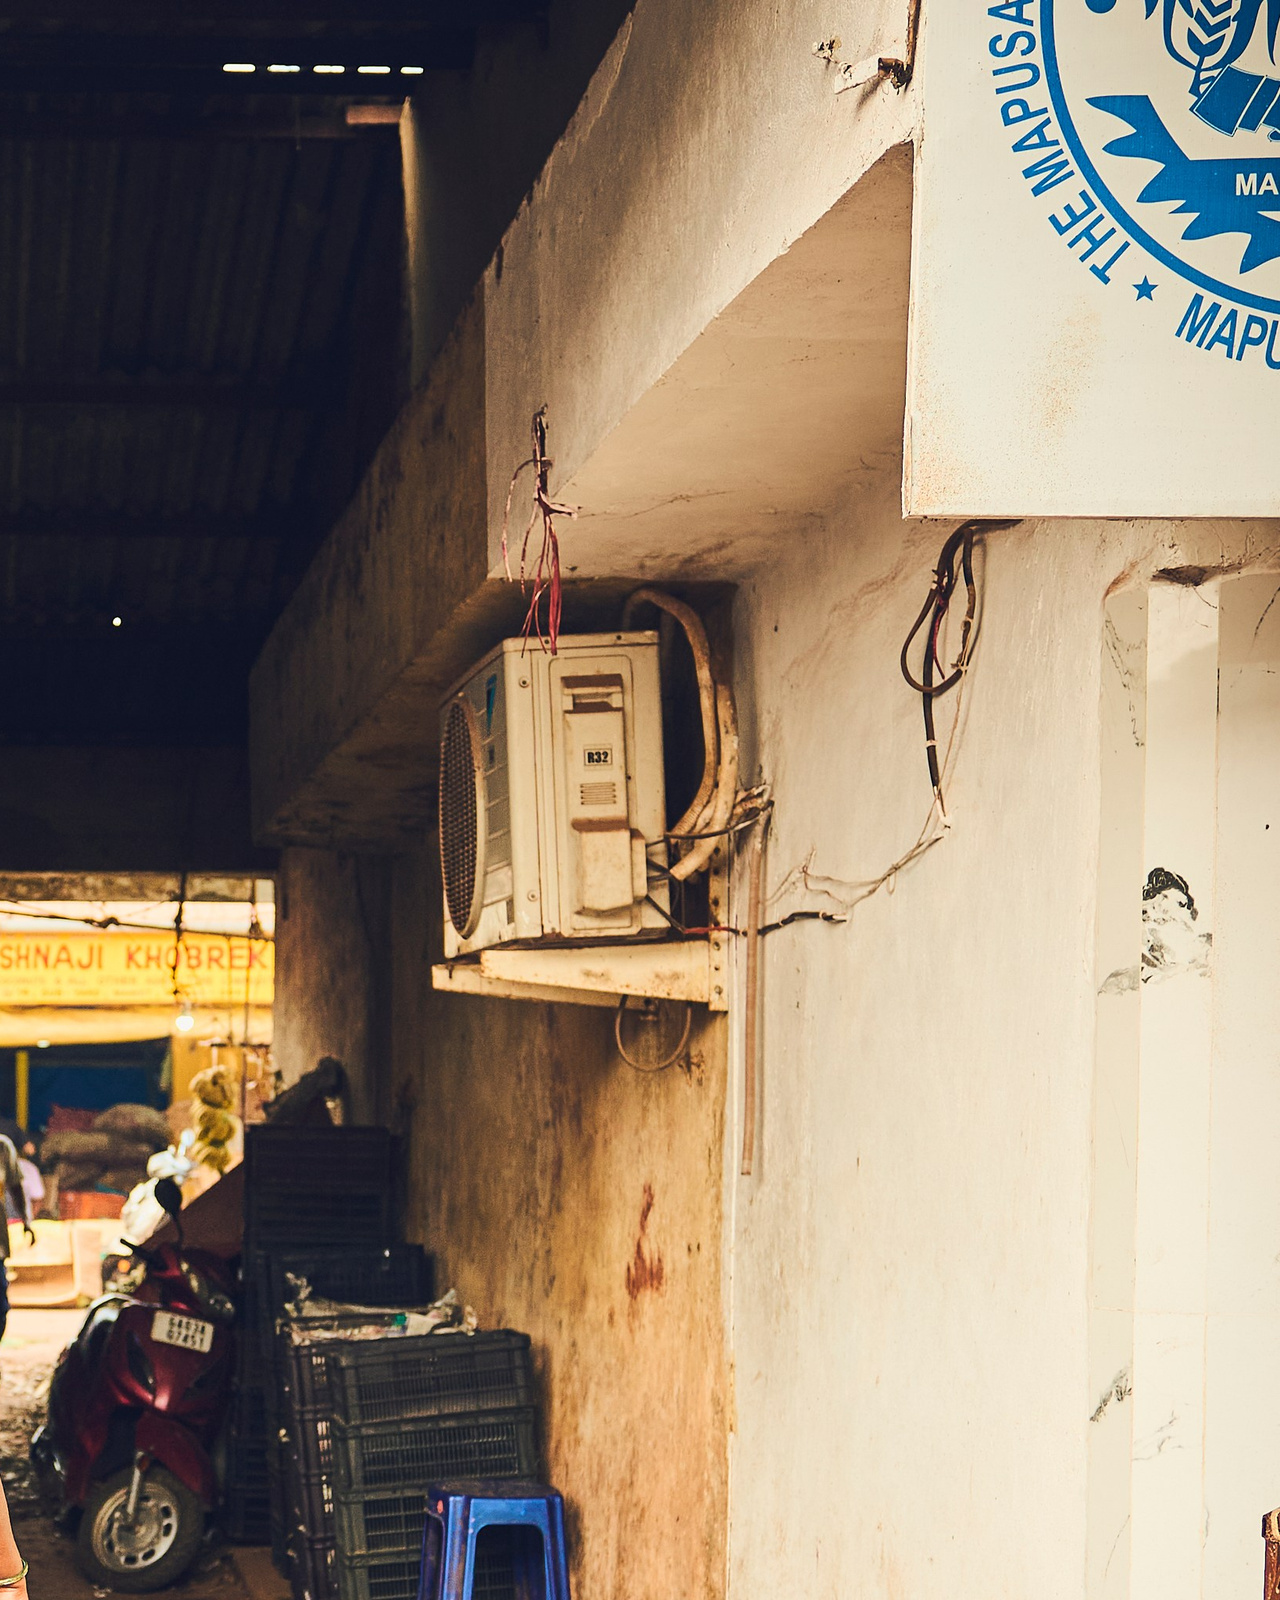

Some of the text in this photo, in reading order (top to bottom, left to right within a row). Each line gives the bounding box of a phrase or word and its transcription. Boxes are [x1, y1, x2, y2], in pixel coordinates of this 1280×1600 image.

[987, 0, 1131, 286] THE MAPUSA
[1235, 172, 1280, 196] MA
[587, 750, 609, 763] R32
[126, 944, 268, 971] KHOBREK
